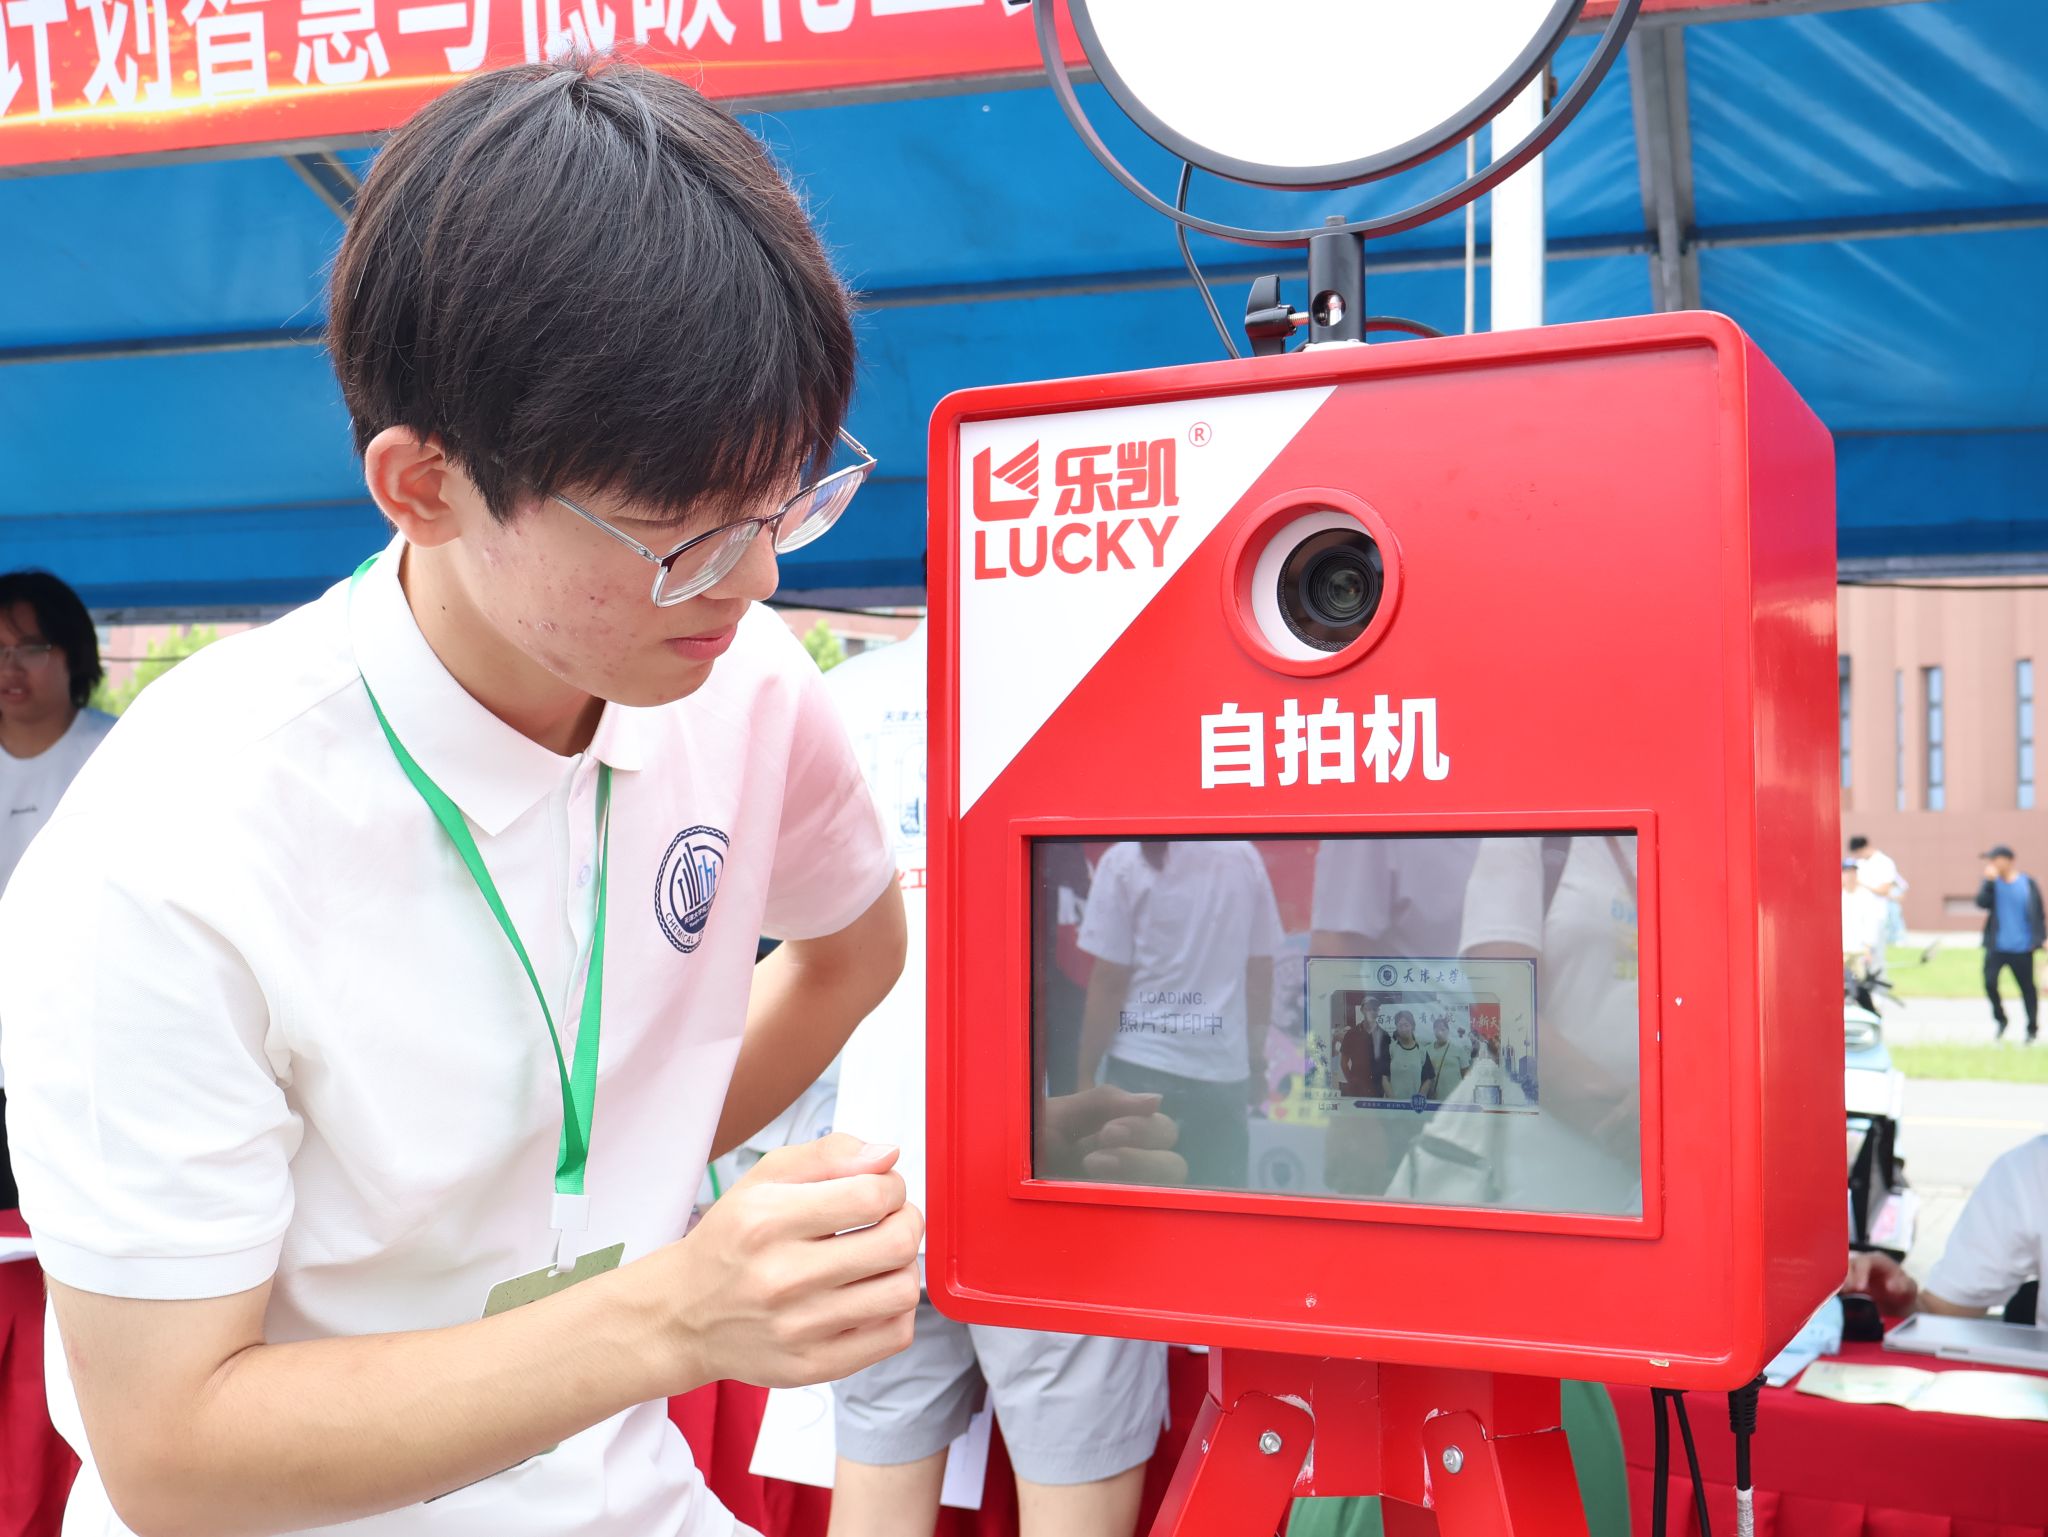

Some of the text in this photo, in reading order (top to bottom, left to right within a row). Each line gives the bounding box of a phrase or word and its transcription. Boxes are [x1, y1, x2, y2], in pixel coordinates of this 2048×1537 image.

[1054, 437, 1180, 516] 乐凯
[974, 515, 1180, 580] LUCKY
[1200, 694, 1450, 789] 自拍机
[665, 912, 694, 944] CHEMICAL
[1119, 1010, 1223, 1036] 照片打印中
